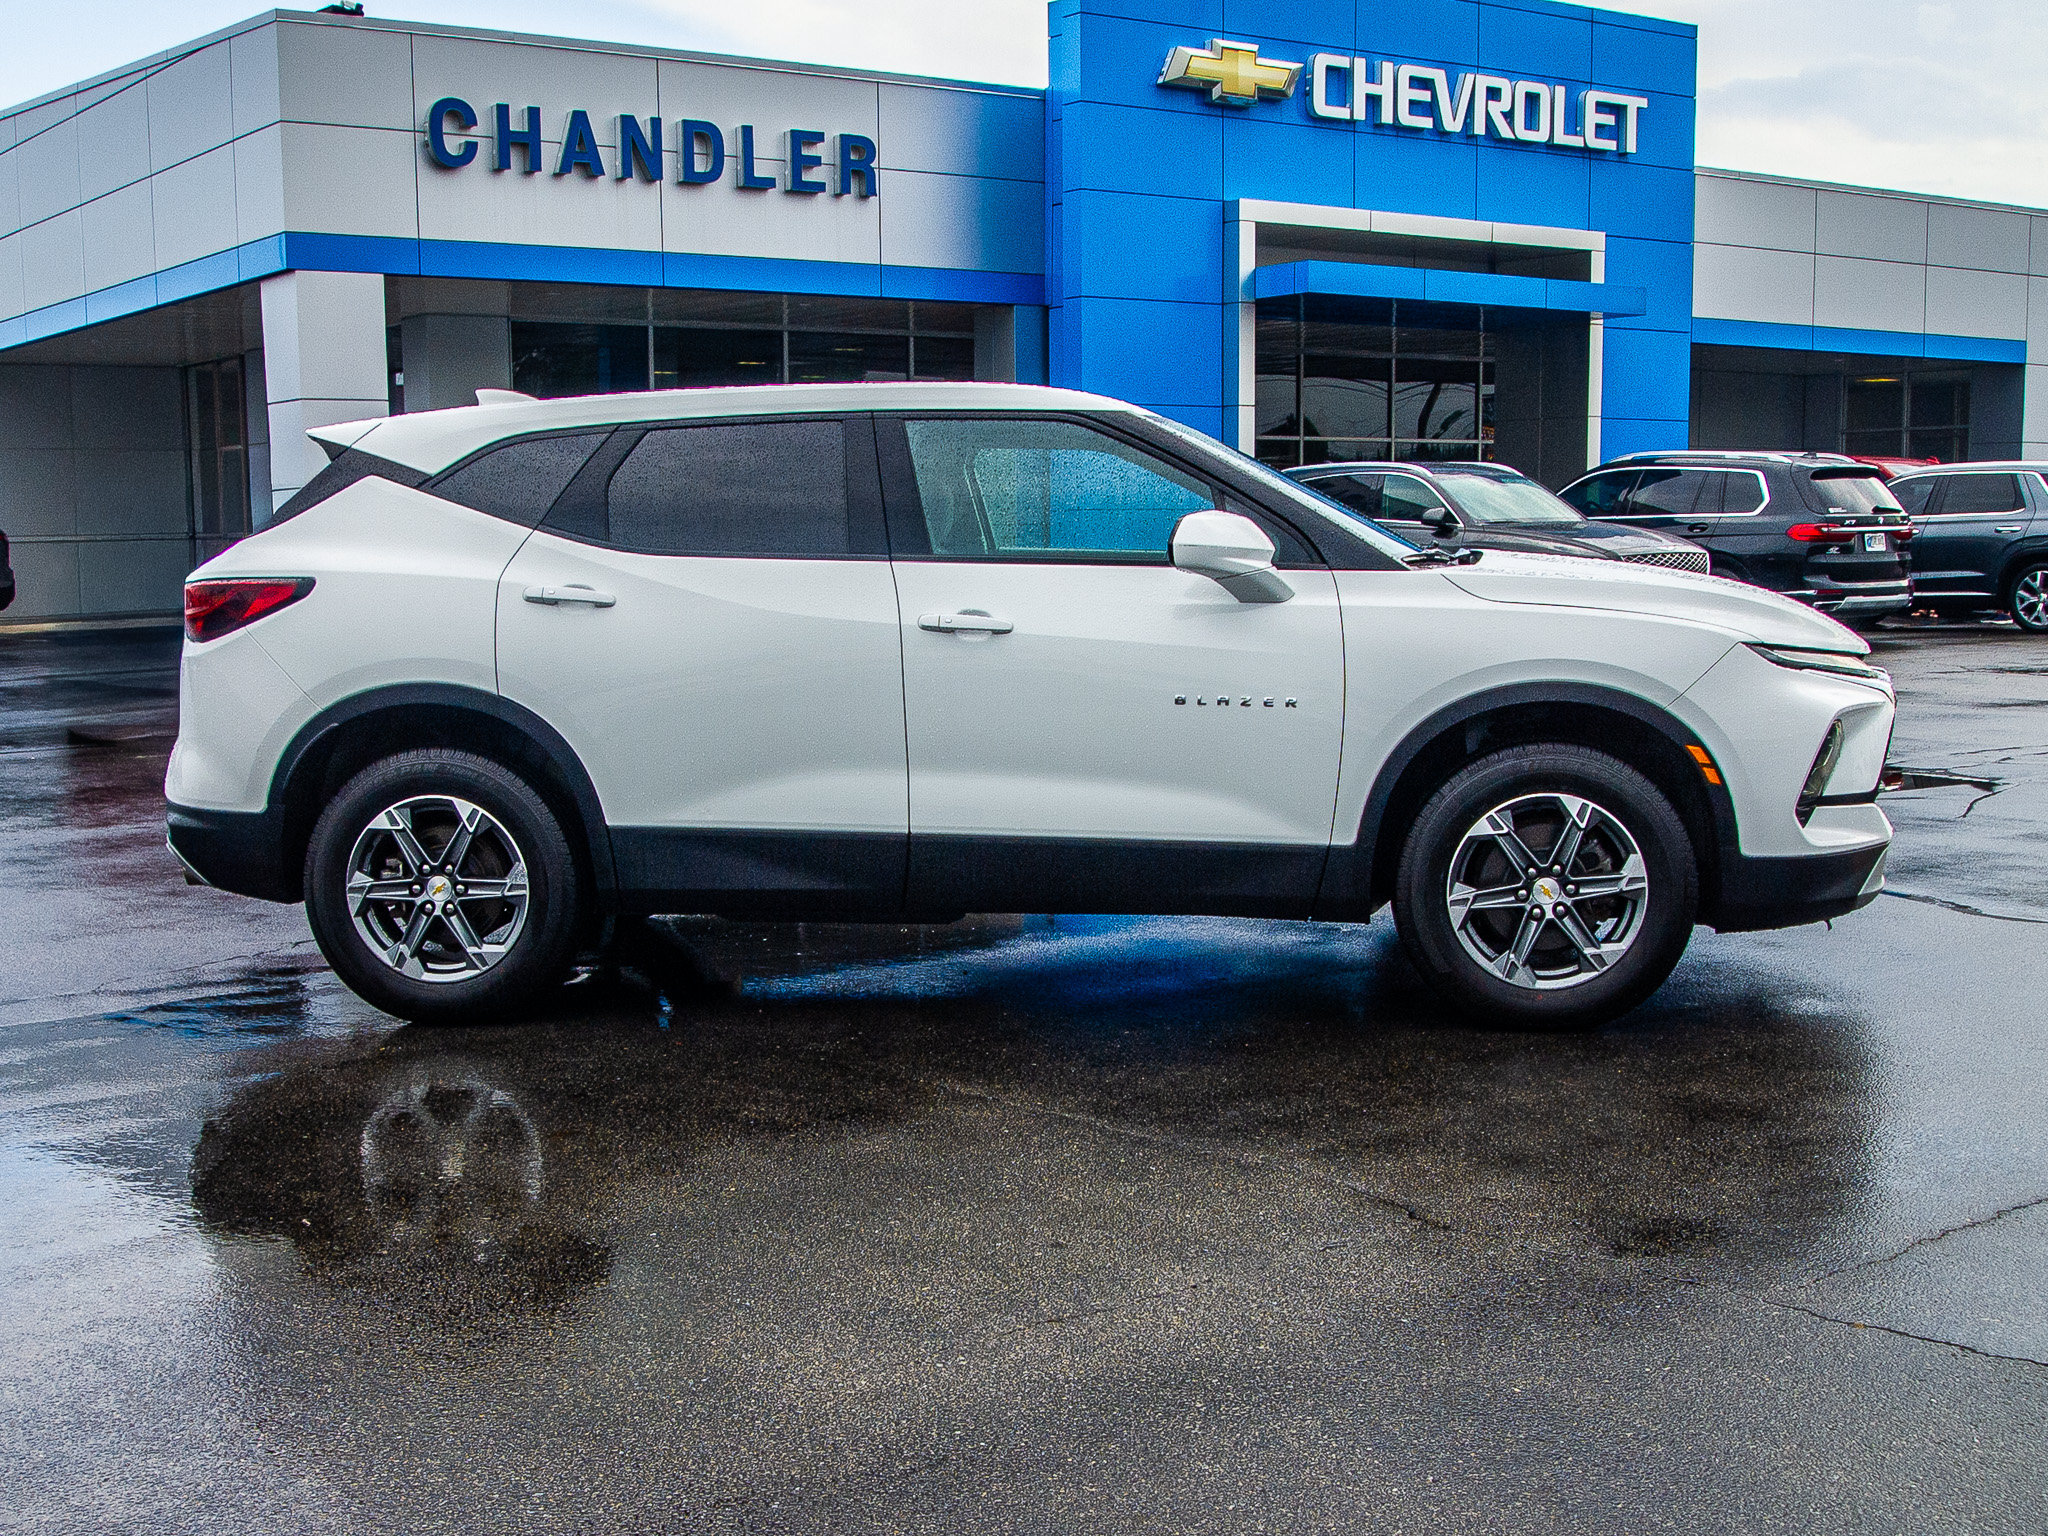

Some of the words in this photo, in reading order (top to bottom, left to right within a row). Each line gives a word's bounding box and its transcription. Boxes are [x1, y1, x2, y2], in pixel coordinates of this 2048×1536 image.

[425, 97, 878, 197] CHANDLER
[1307, 52, 1648, 154] CHEVROLET
[1174, 694, 1298, 708] BLAZER
